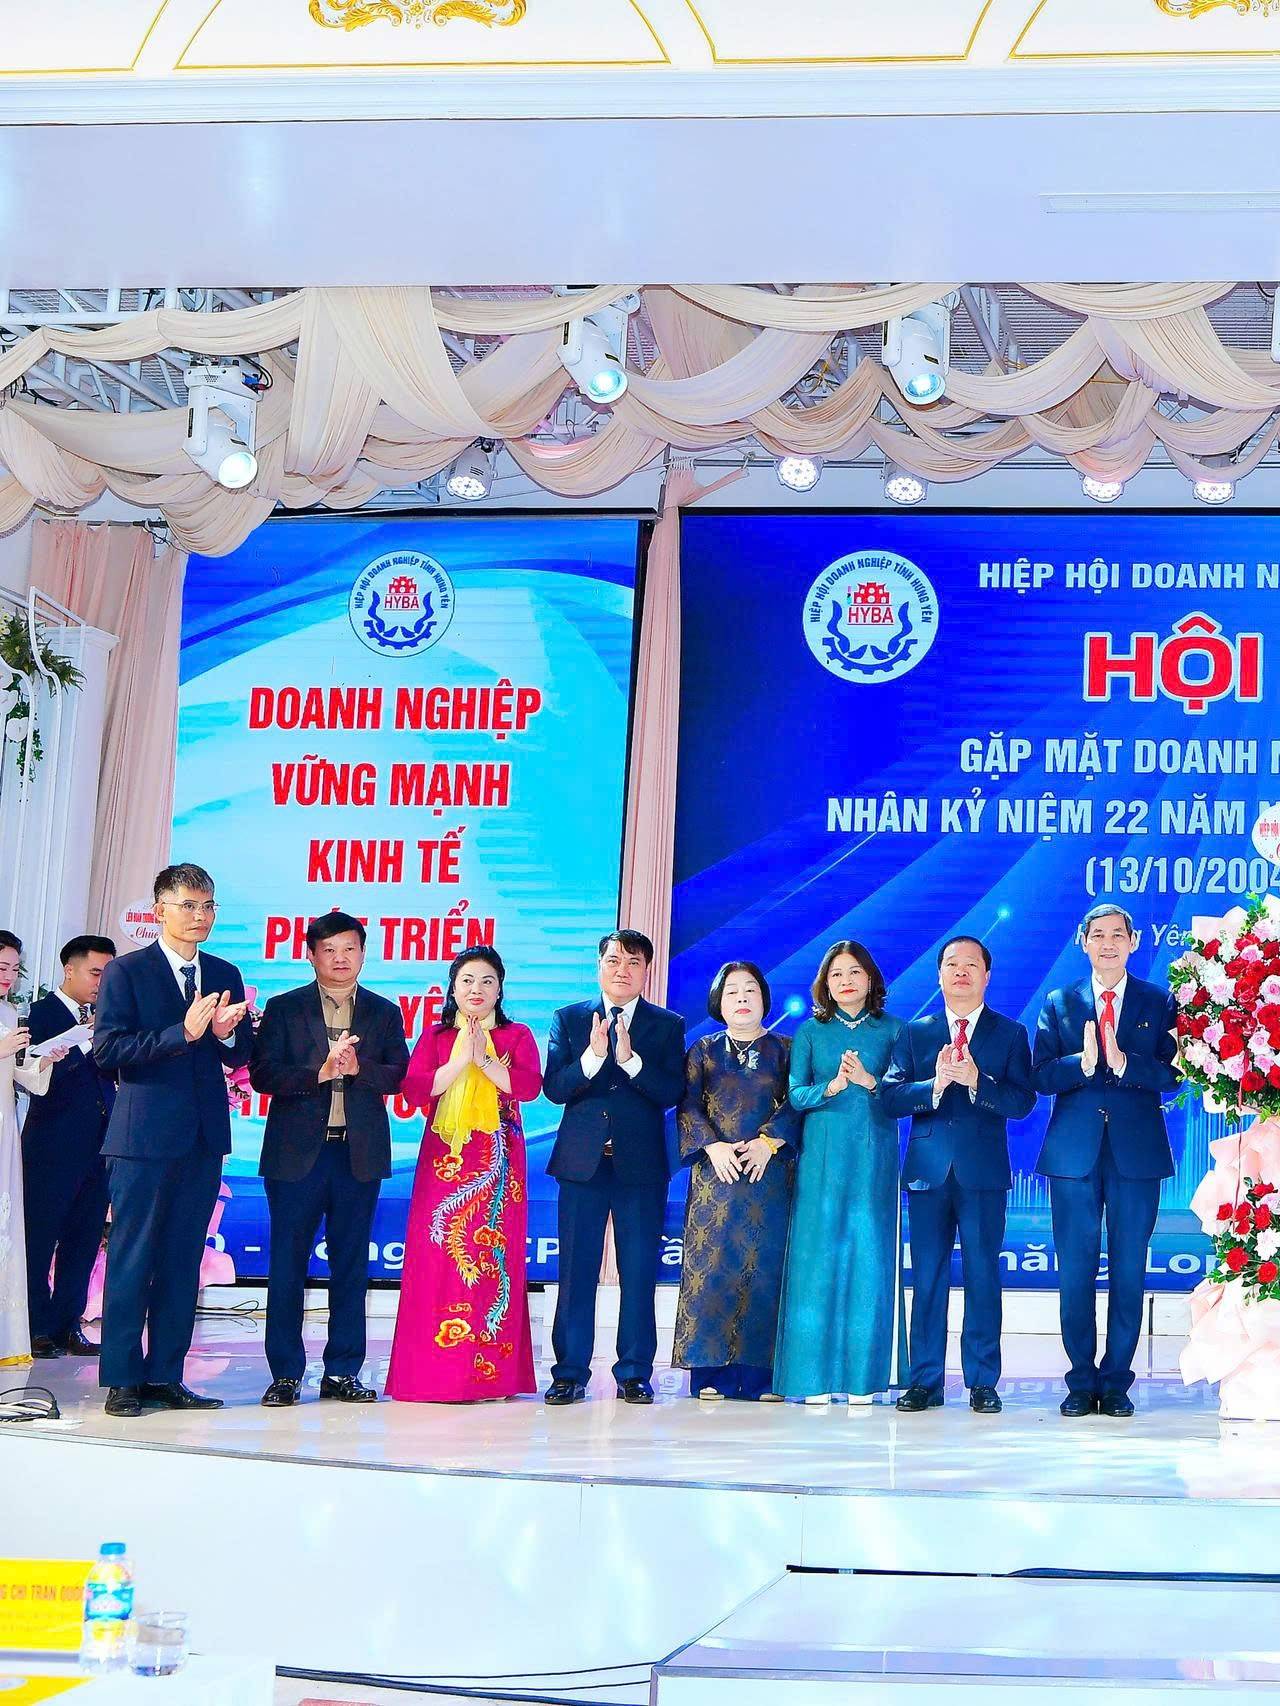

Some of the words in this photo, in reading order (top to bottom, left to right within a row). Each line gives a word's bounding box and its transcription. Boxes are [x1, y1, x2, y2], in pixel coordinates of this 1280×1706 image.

[384, 595, 420, 609] HYBA
[980, 558, 1053, 593] HIỆP
[1067, 558, 1119, 593] HỘI
[1133, 563, 1244, 588] DOANH
[848, 606, 894, 624] HYBA
[1083, 611, 1263, 715] HỘI
[250, 687, 382, 729] DOANH
[396, 680, 540, 738] NGHIỆP
[961, 732, 1031, 780] GẶP
[1046, 732, 1122, 780] MẶT
[1135, 740, 1256, 773] DOANH
[273, 756, 376, 805] VỮNG
[390, 764, 509, 815] MẠNH
[827, 792, 927, 833] NHÂN
[941, 787, 985, 832] KỶ
[999, 792, 1091, 840] NIỆM
[1105, 800, 1148, 833] 22
[1162, 793, 1244, 834] NĂM
[308, 840, 403, 882] KINH
[418, 828, 463, 882] TẾ
[380, 900, 495, 961] TRIỂN
